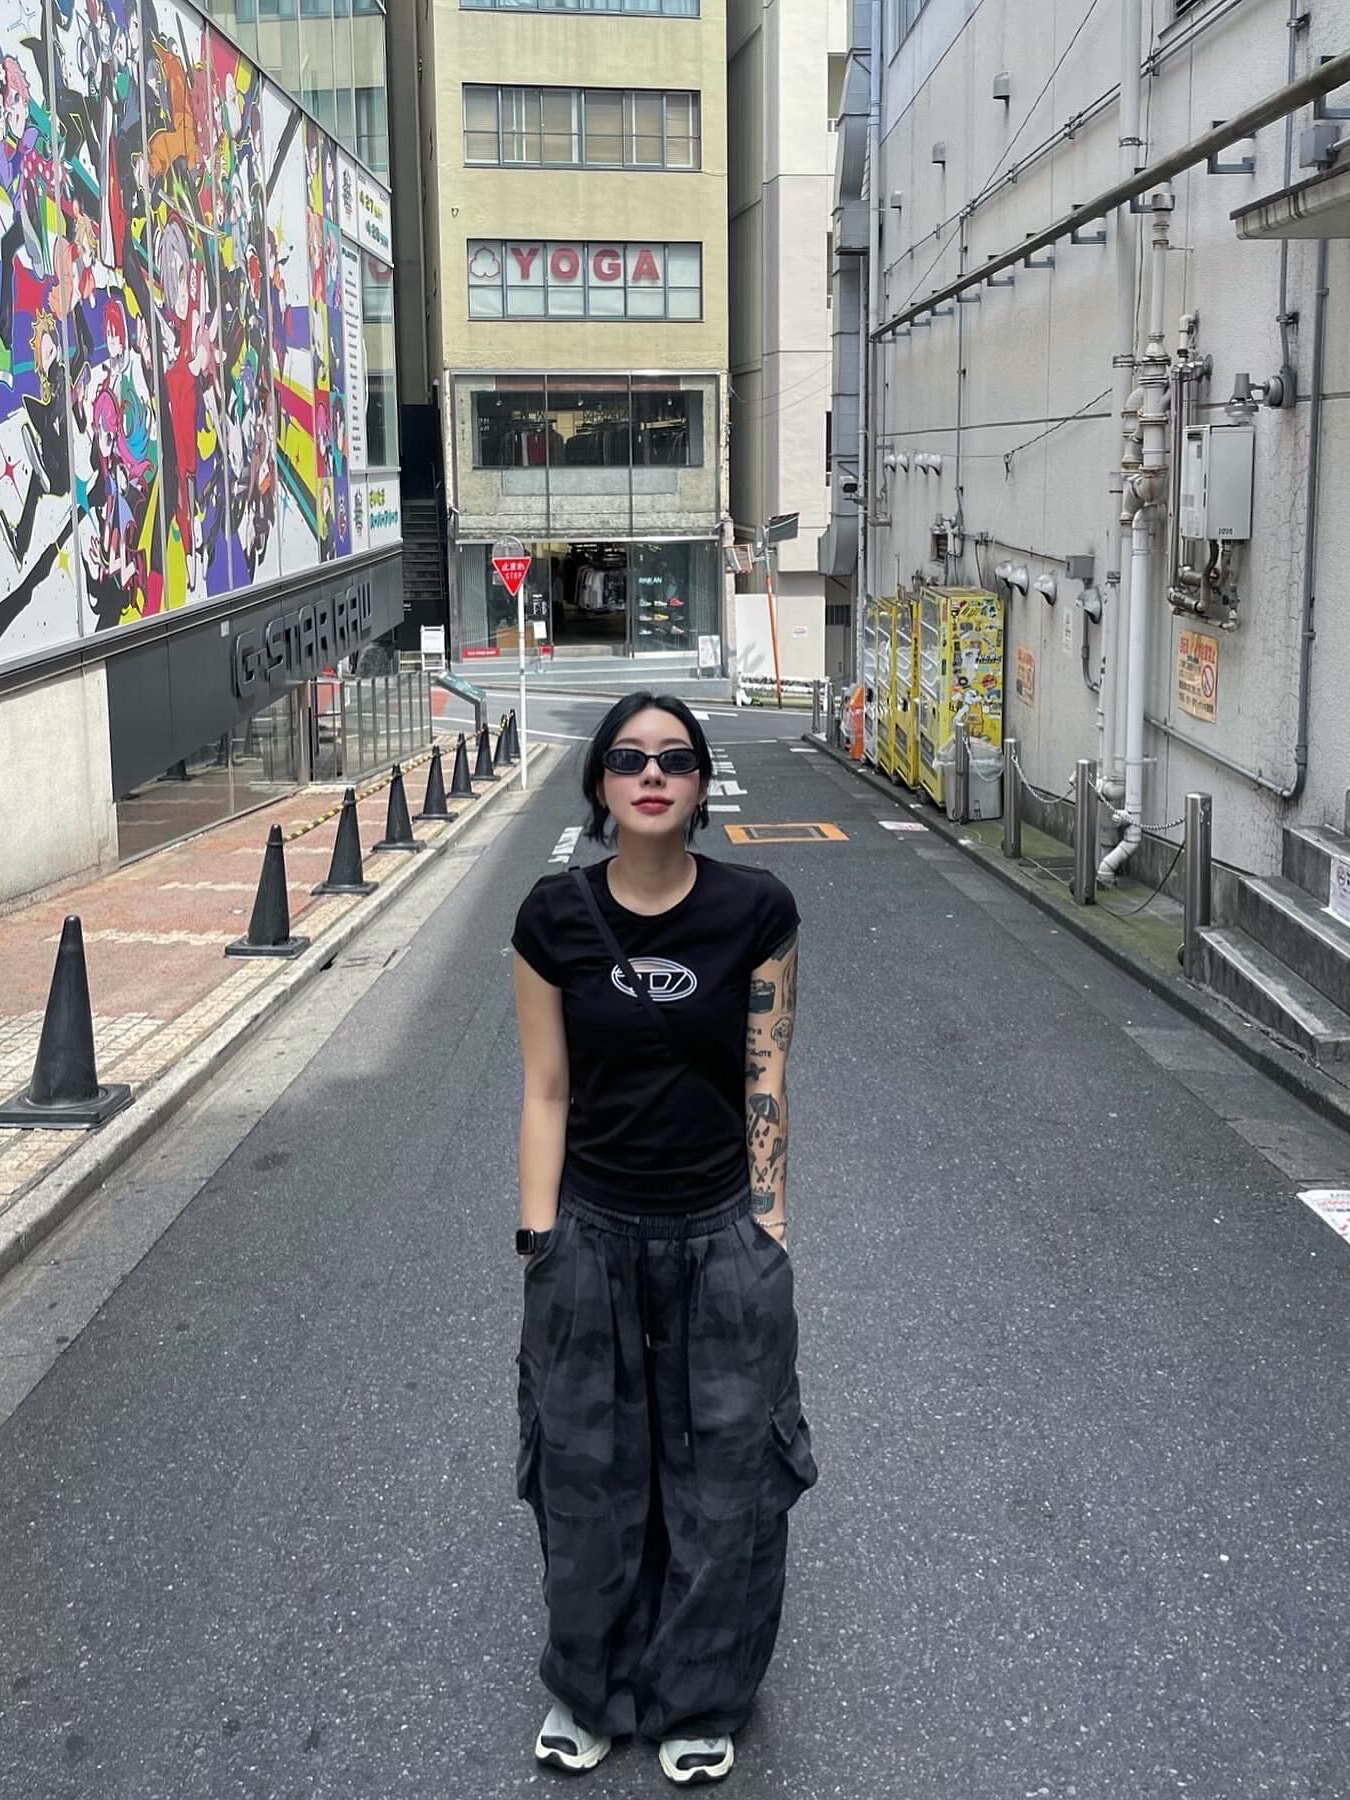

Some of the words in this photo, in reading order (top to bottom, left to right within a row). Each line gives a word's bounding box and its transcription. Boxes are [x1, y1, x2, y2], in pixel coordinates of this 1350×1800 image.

[510, 247, 661, 282] YOGA
[501, 561, 525, 571] 止まれ
[505, 571, 522, 580] STOP
[233, 599, 334, 698] G-STAR
[333, 581, 373, 657] RAW
